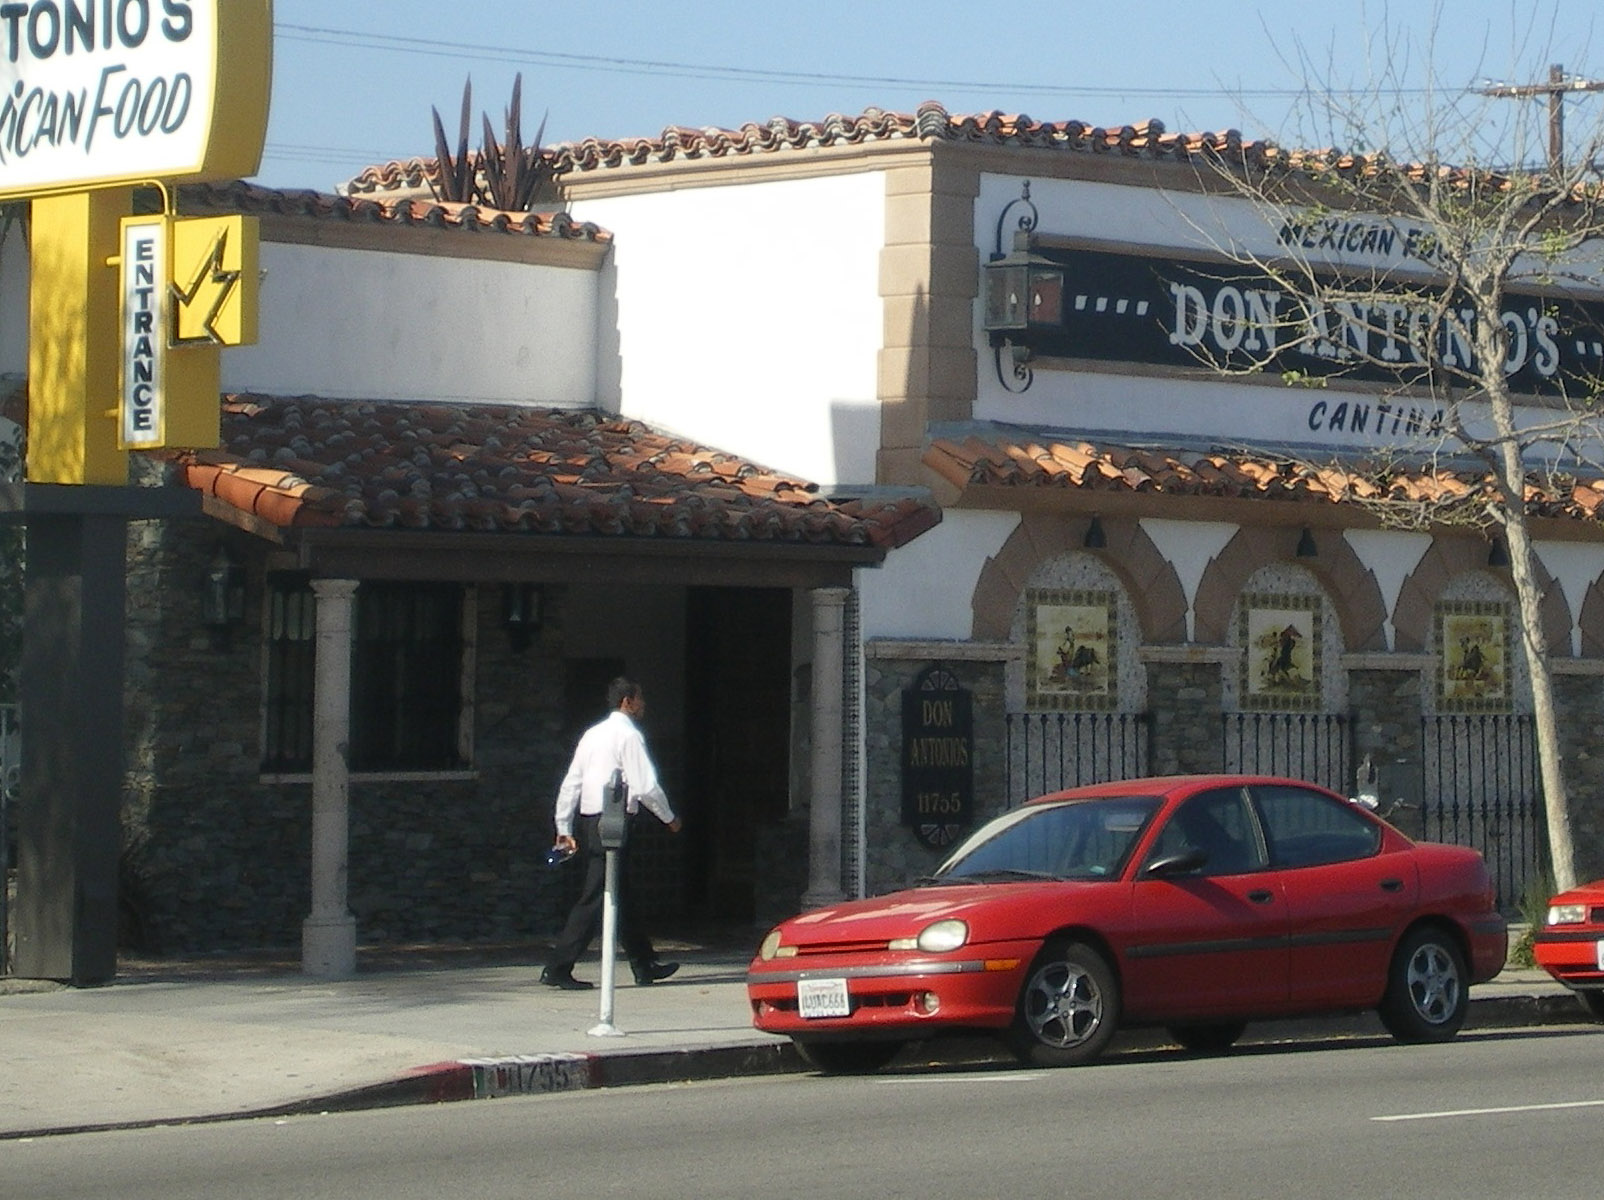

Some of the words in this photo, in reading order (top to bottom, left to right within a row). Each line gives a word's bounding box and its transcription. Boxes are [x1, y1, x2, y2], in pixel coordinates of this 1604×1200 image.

[1277, 217, 1395, 257] MEXICAN
[133, 239, 154, 430] ENTRANCE
[1170, 282, 1281, 351] DON
[1300, 295, 1560, 377] ANTONO'S
[1308, 401, 1444, 438] CANTINA
[922, 700, 953, 727] DON
[917, 792, 962, 814] 11755
